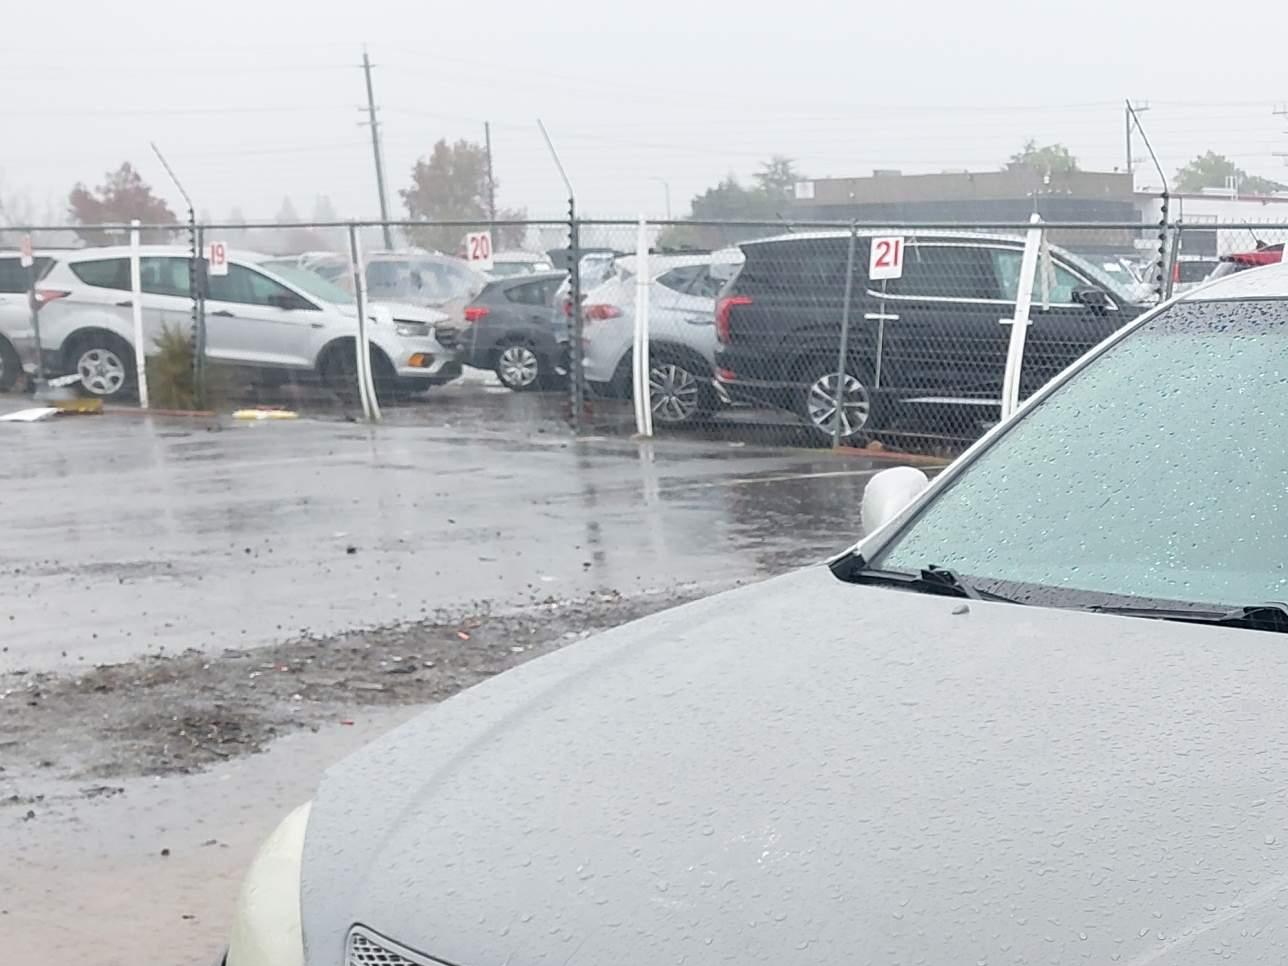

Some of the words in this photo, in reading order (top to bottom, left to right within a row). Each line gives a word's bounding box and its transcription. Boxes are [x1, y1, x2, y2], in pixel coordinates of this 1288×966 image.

[211, 244, 225, 265] 19
[471, 236, 489, 259] 20
[875, 240, 899, 267] 21
